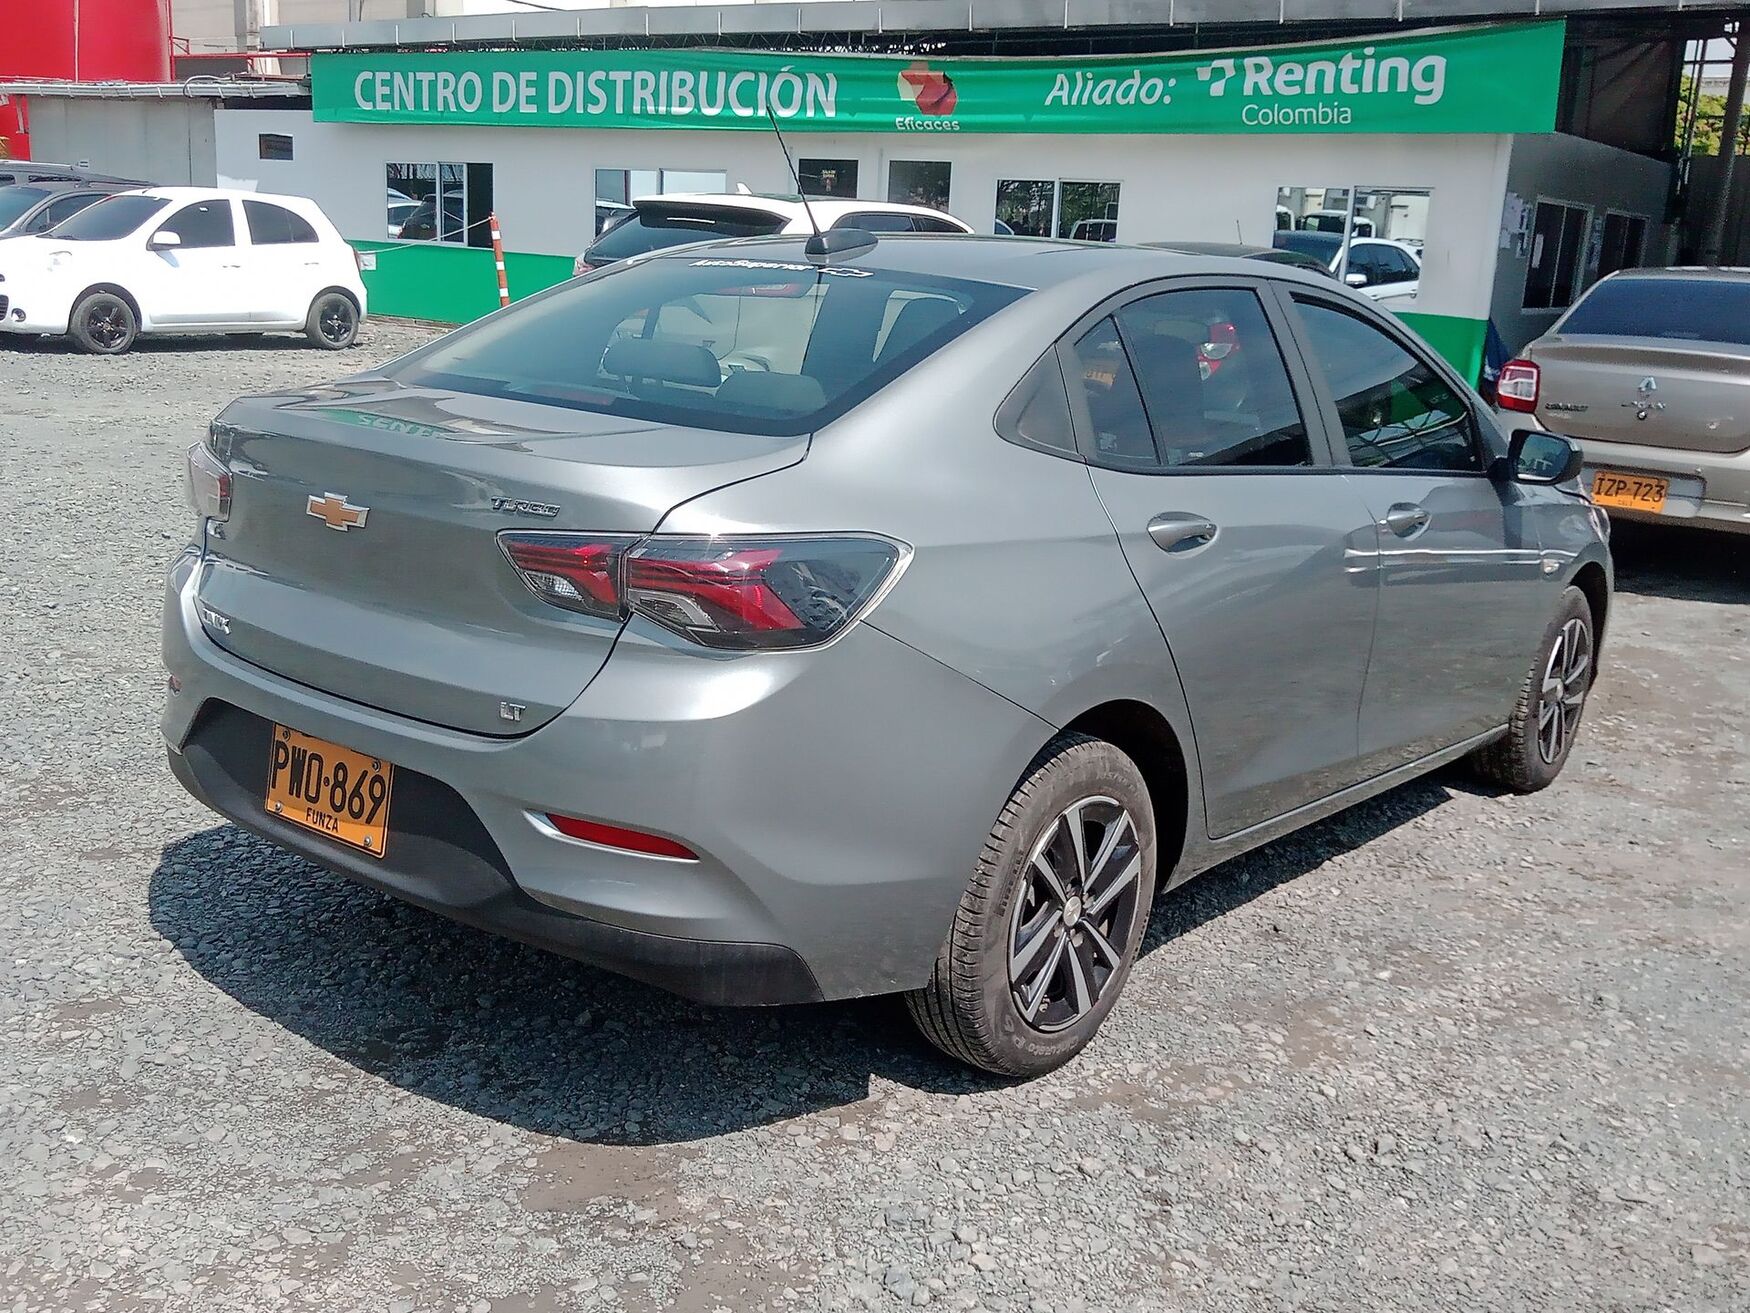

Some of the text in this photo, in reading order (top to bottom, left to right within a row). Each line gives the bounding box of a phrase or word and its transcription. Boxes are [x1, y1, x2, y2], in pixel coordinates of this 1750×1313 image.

[1044, 69, 1177, 106] Aliado:
[1243, 47, 1448, 105] Renting
[354, 66, 838, 118] CENTRO DE DISTRIBUCIÓN
[895, 115, 961, 131] Eficaces
[1242, 101, 1352, 126] Colombia
[500, 701, 527, 722] LT
[305, 807, 339, 833] FUNZA
